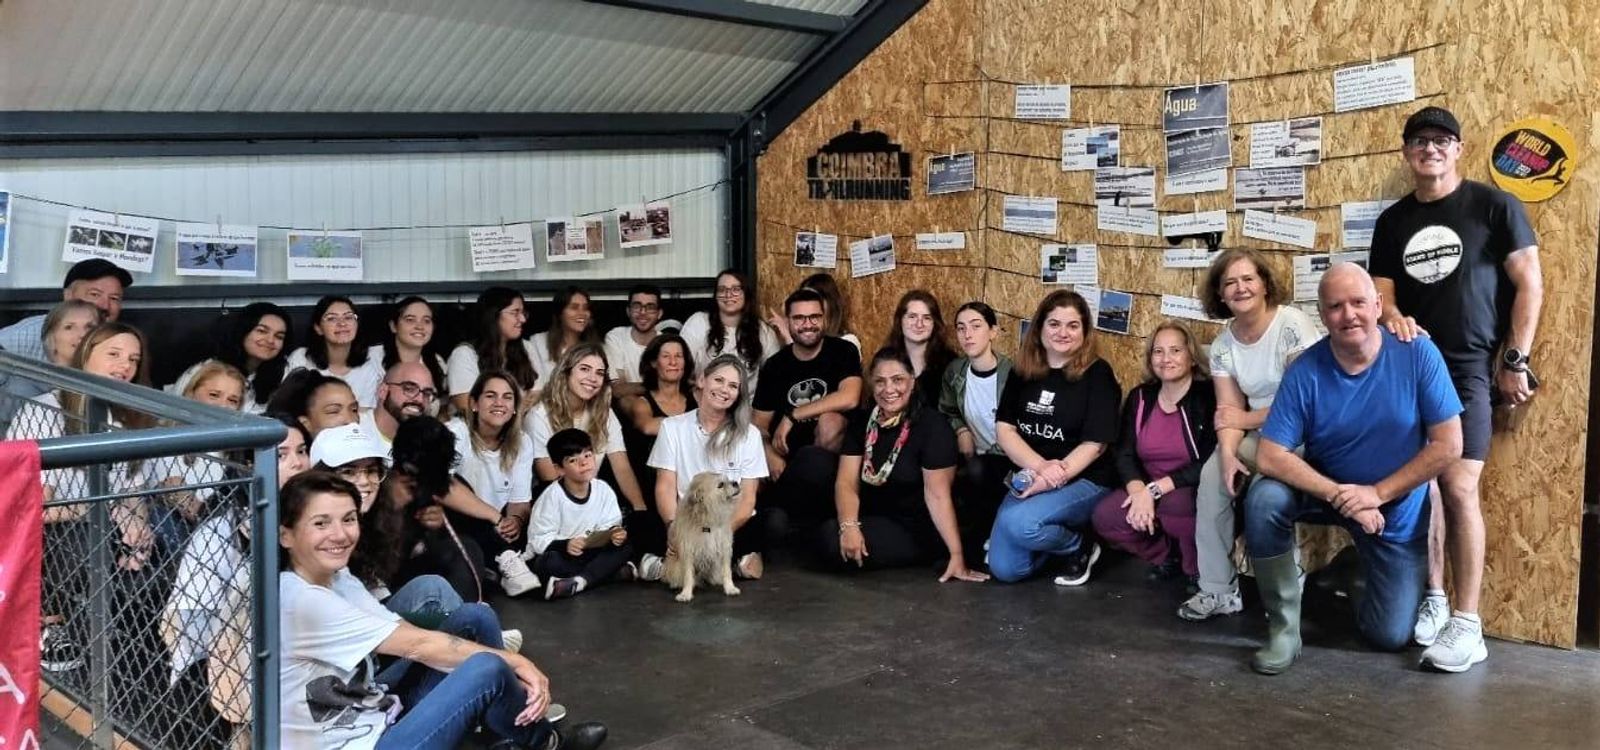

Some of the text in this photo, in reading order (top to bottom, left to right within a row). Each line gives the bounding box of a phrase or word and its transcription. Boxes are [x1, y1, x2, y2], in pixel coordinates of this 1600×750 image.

[1165, 91, 1197, 117] Água
[1515, 130, 1552, 156] WORLD
[817, 151, 901, 178] COIMBRA
[1496, 153, 1519, 173] DAY
